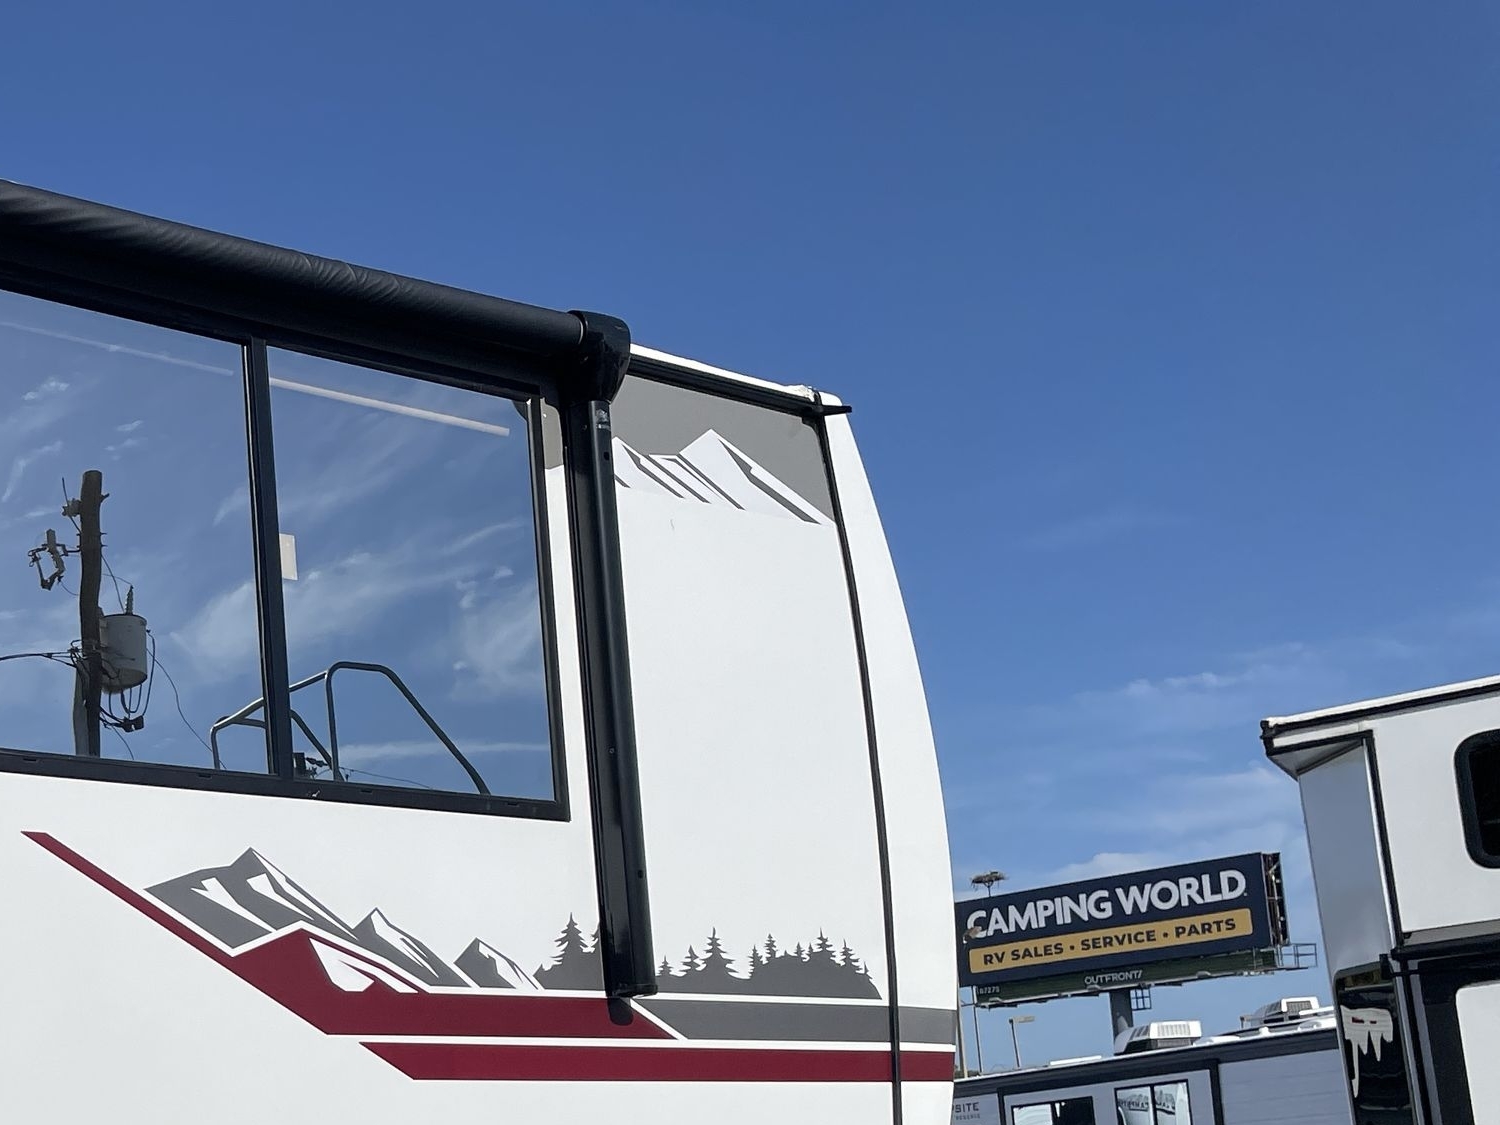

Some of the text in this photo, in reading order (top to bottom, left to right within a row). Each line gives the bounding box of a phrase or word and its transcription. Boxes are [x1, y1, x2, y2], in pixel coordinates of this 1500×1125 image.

[967, 870, 1246, 937] CAMPING WORLD
[984, 918, 1236, 965] RV SALES SERVICE PARTS
